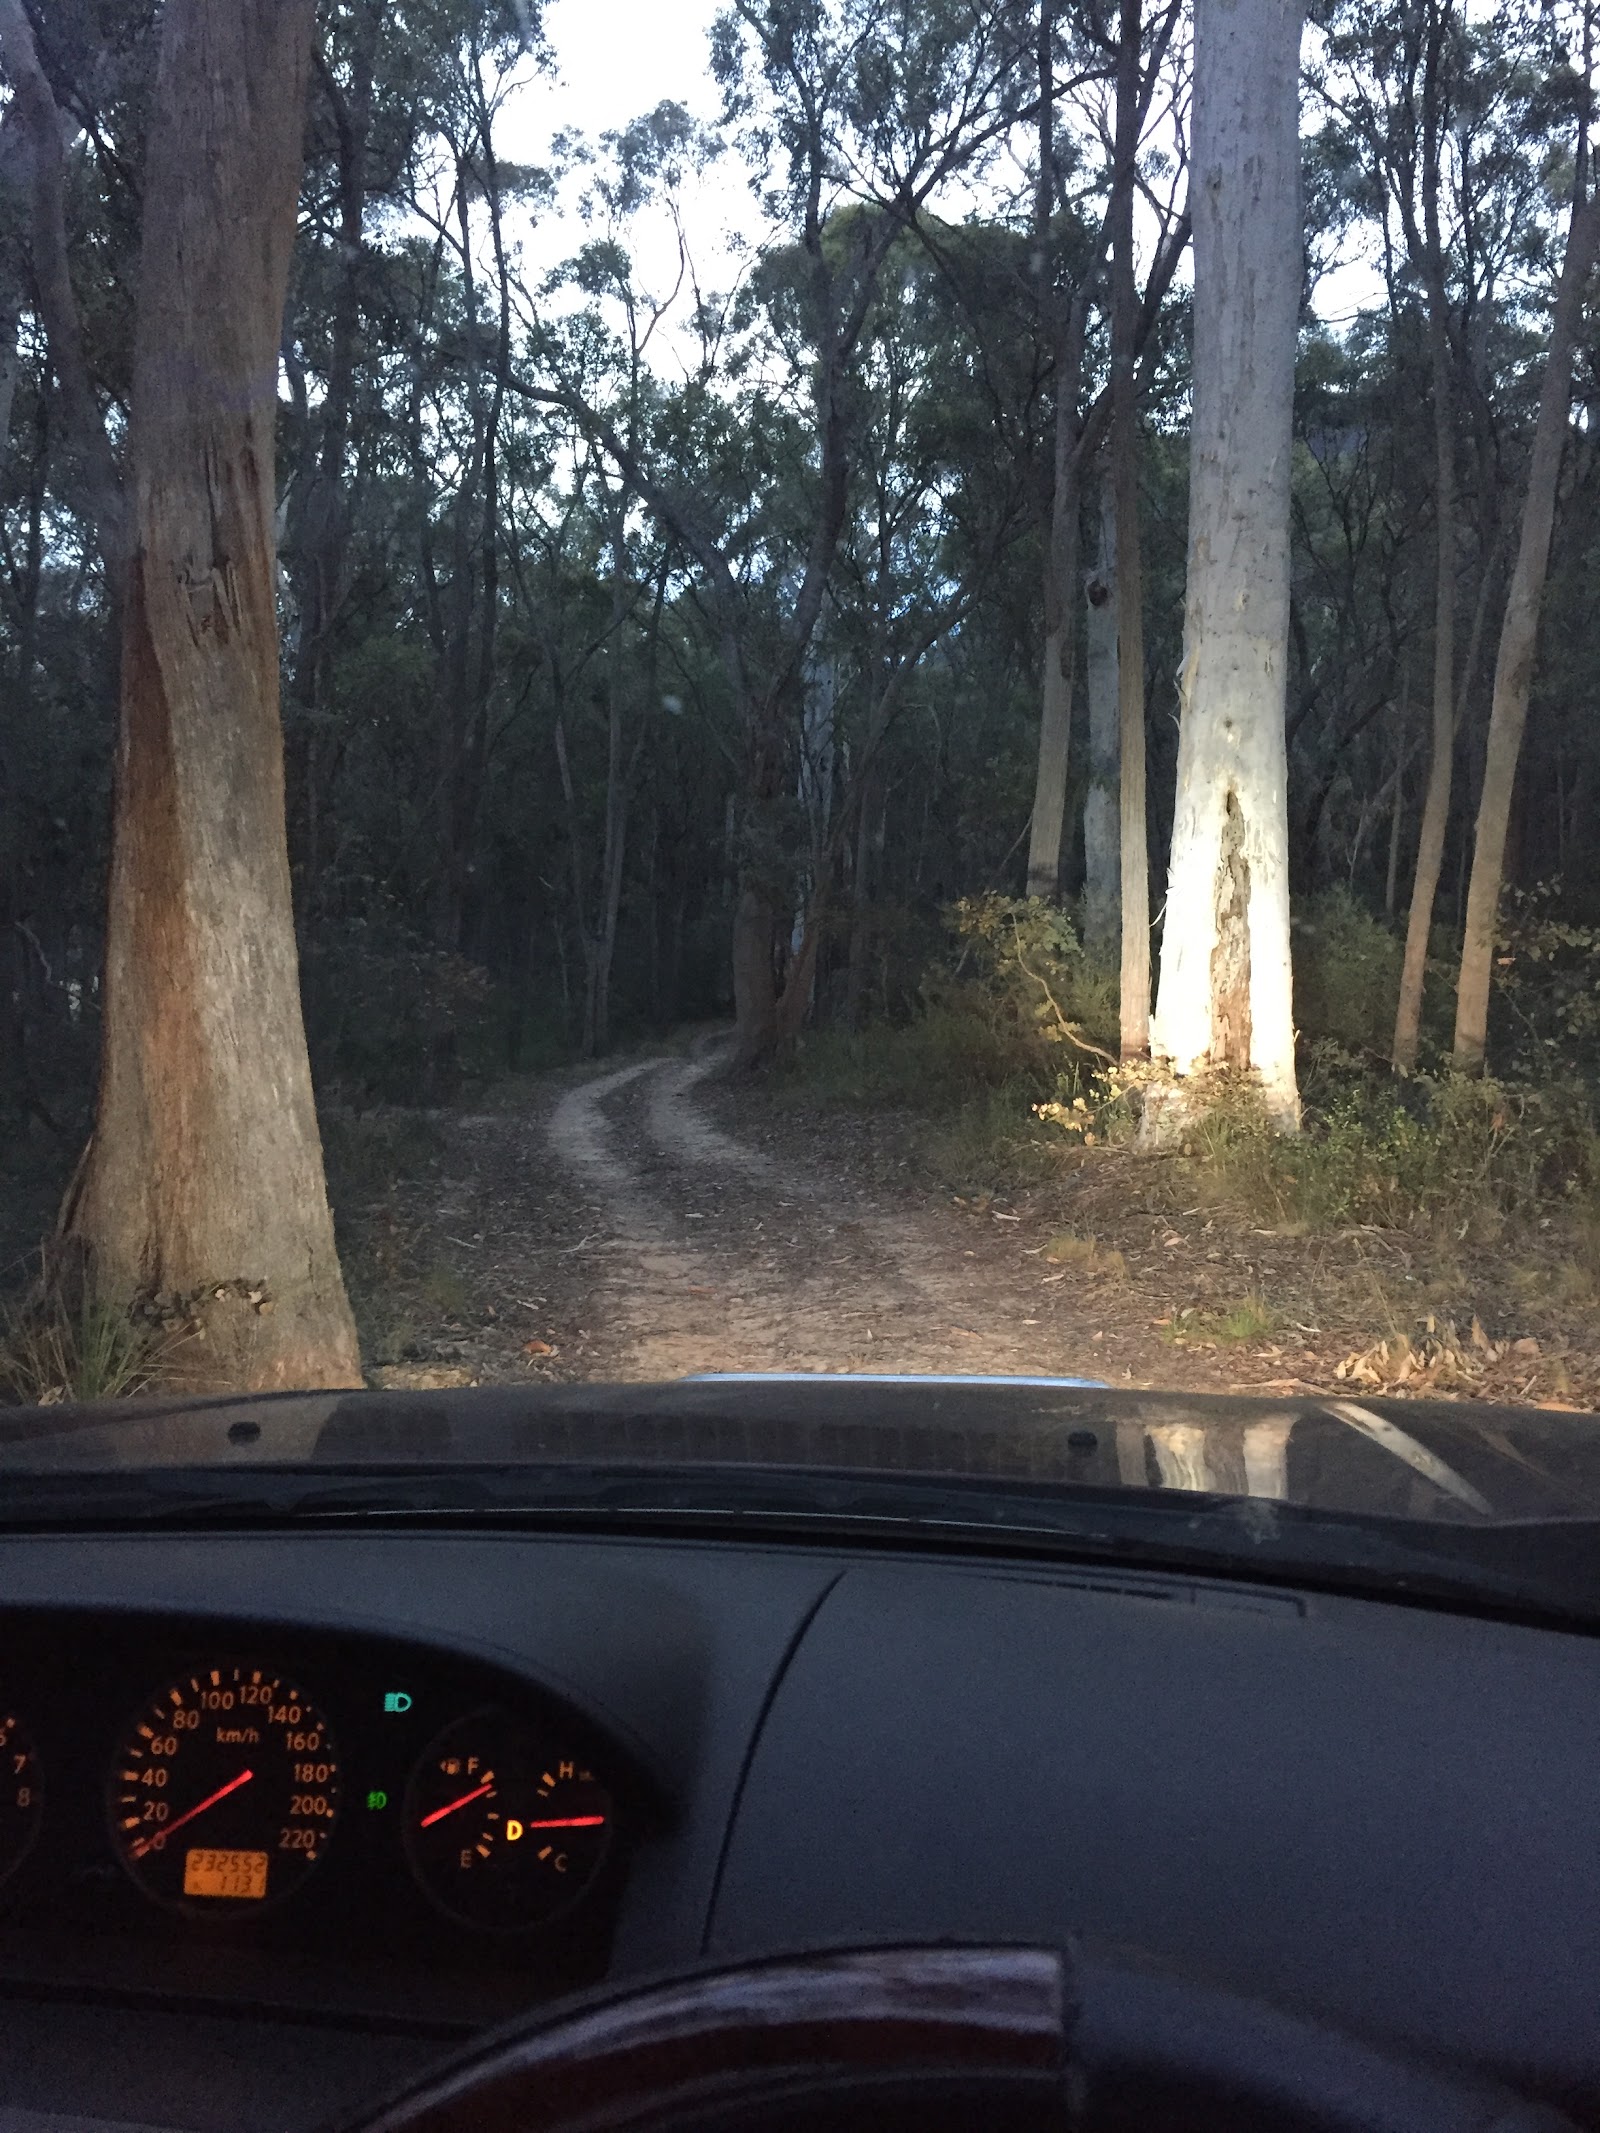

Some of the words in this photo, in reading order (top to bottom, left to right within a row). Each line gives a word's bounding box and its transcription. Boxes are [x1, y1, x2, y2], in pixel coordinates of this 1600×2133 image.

[200, 1691, 234, 1710] 100
[240, 1685, 272, 1704] 120
[172, 1709, 200, 1730] 80
[267, 1704, 301, 1724] 140
[215, 1727, 260, 1743] km/h
[286, 1732, 320, 1751] 160
[151, 1736, 177, 1755] 60
[13, 1754, 26, 1774] 7
[293, 1763, 329, 1782] 180
[467, 1757, 479, 1775] F
[558, 1760, 574, 1779] H
[141, 1768, 168, 1788] 40
[16, 1787, 31, 1808] 8
[290, 1796, 327, 1816] 200
[143, 1801, 168, 1822] 20
[278, 1829, 315, 1850] 220
[506, 1819, 524, 1841] D
[460, 1849, 473, 1868] E
[554, 1853, 569, 1873] C
